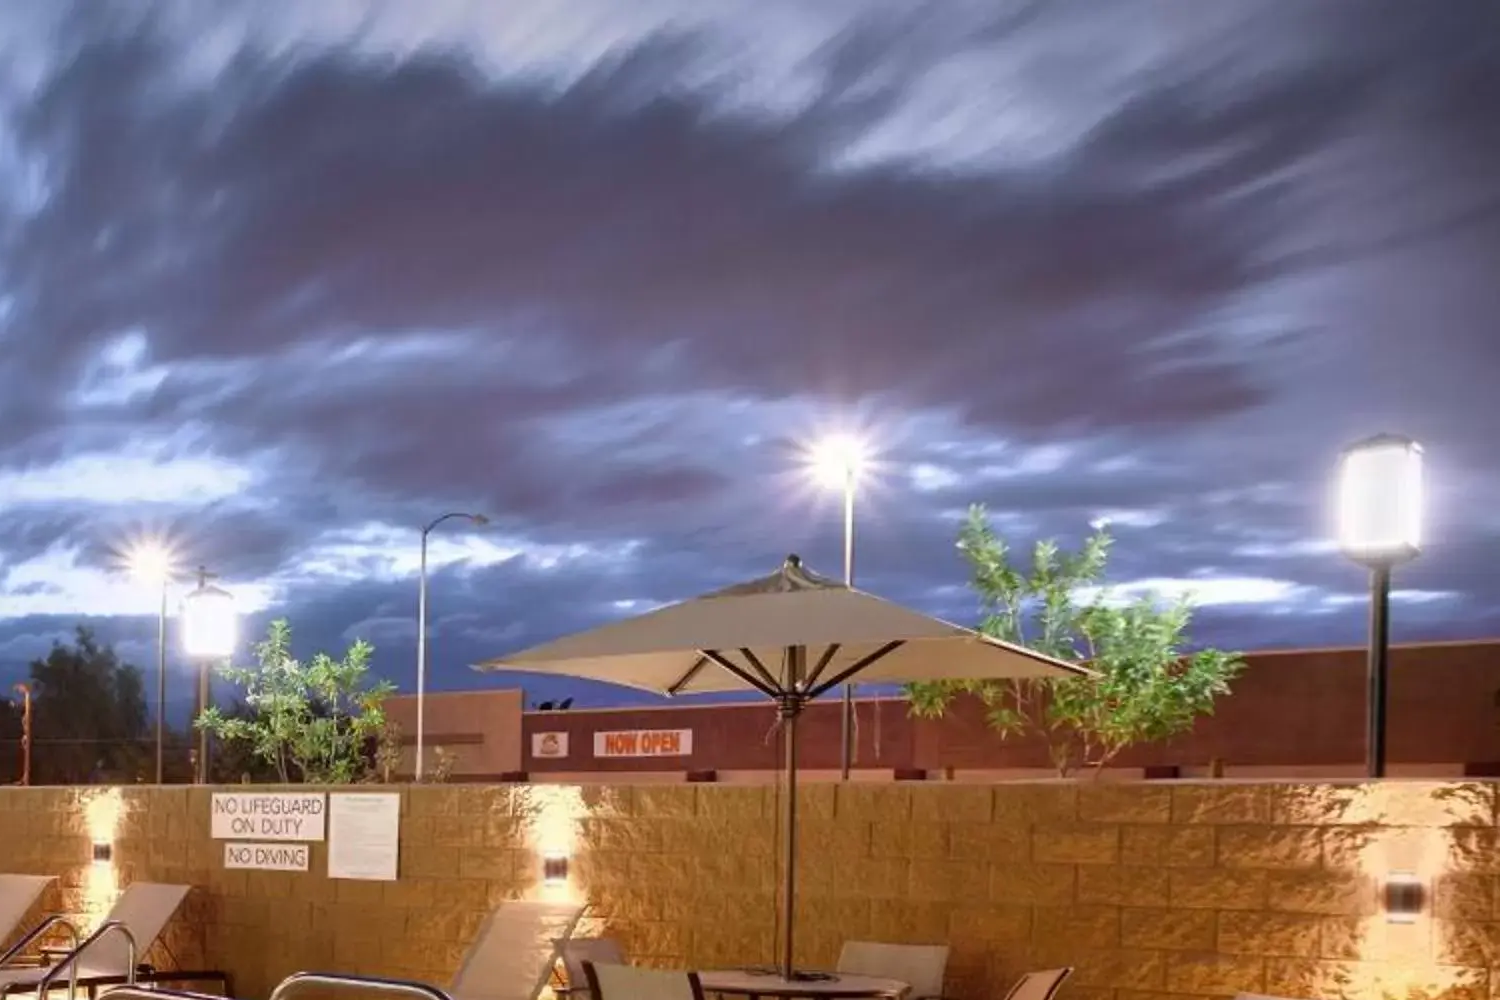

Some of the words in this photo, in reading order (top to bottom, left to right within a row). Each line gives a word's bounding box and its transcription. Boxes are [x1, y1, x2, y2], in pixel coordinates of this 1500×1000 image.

[605, 734, 638, 755] NOW
[642, 732, 681, 754] OPEN
[214, 797, 237, 815] NO
[241, 798, 323, 816] LIFEGUARD
[231, 817, 255, 834] ON
[261, 818, 303, 835] DUTY
[228, 847, 250, 864] NO
[255, 848, 306, 867] DIVING
